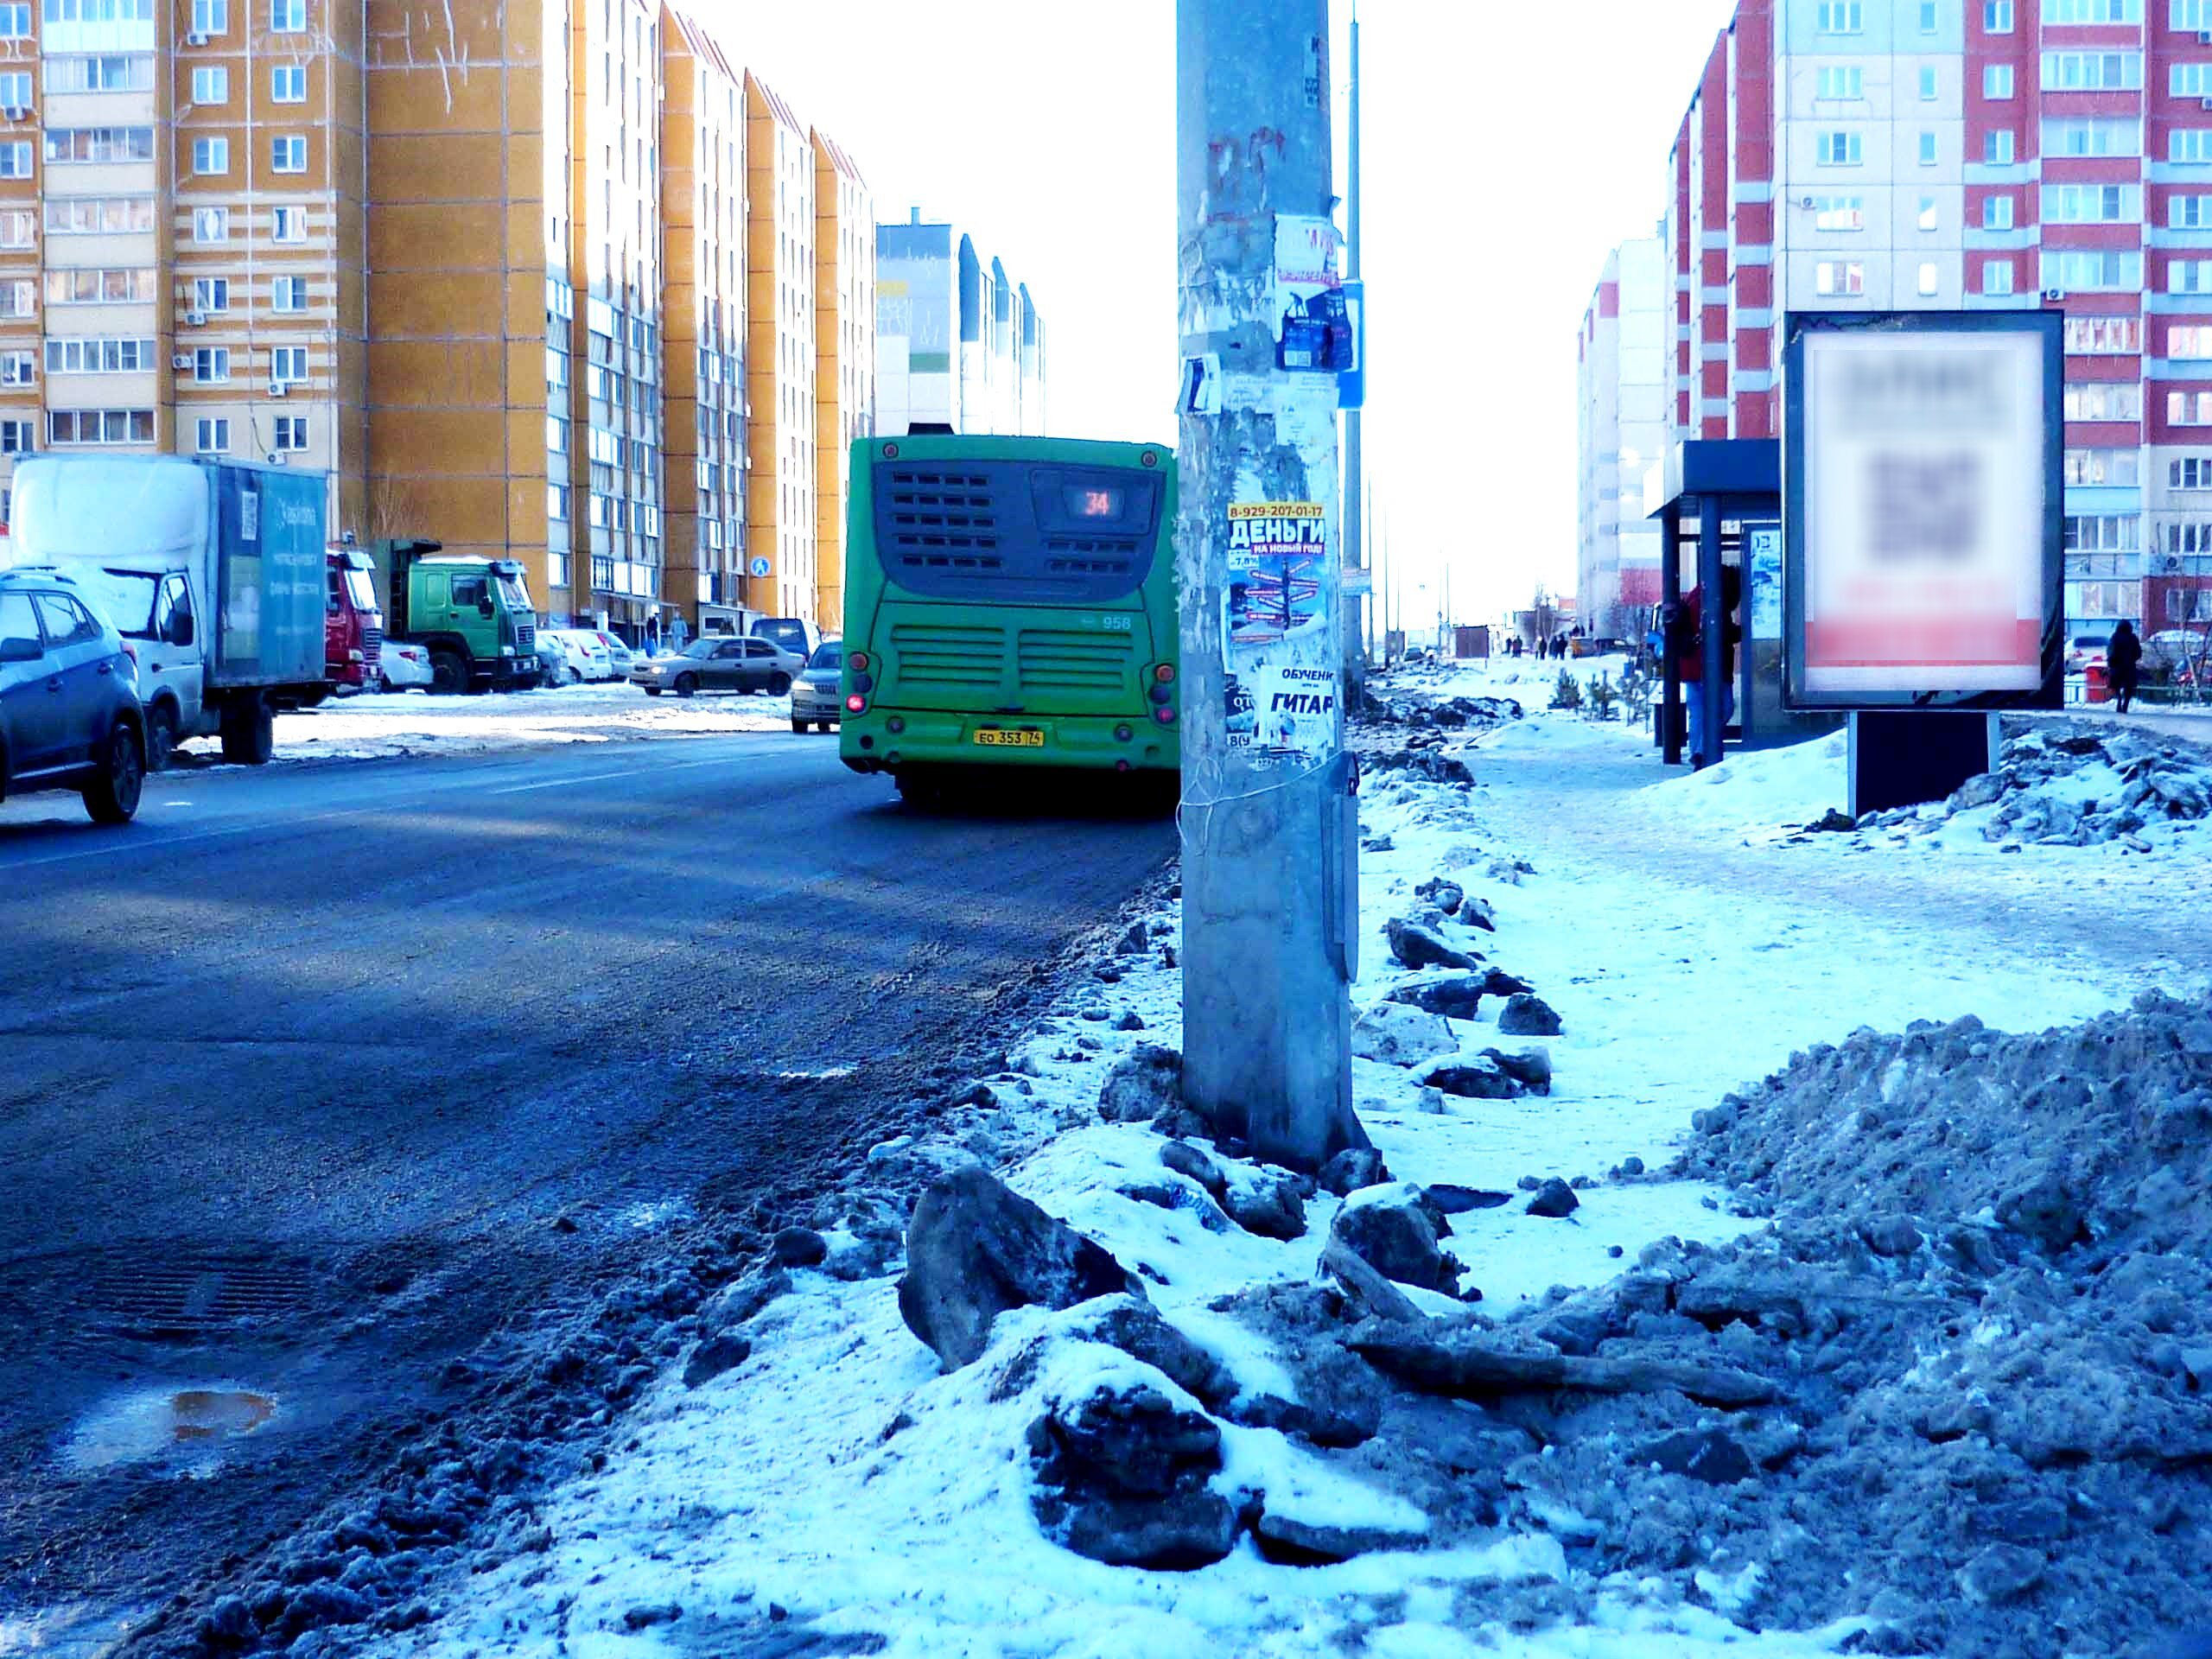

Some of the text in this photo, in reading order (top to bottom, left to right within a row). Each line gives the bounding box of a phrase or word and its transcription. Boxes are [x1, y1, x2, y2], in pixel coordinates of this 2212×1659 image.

[1085, 491, 1109, 515] 34
[1230, 506, 1323, 518] 8-929-207-01-17
[1230, 519, 1325, 549] ДЕНЬГИ
[1253, 544, 1268, 553] НА
[1103, 616, 1131, 630] 958
[999, 731, 1021, 744] 353
[1028, 732, 1040, 743] 74
